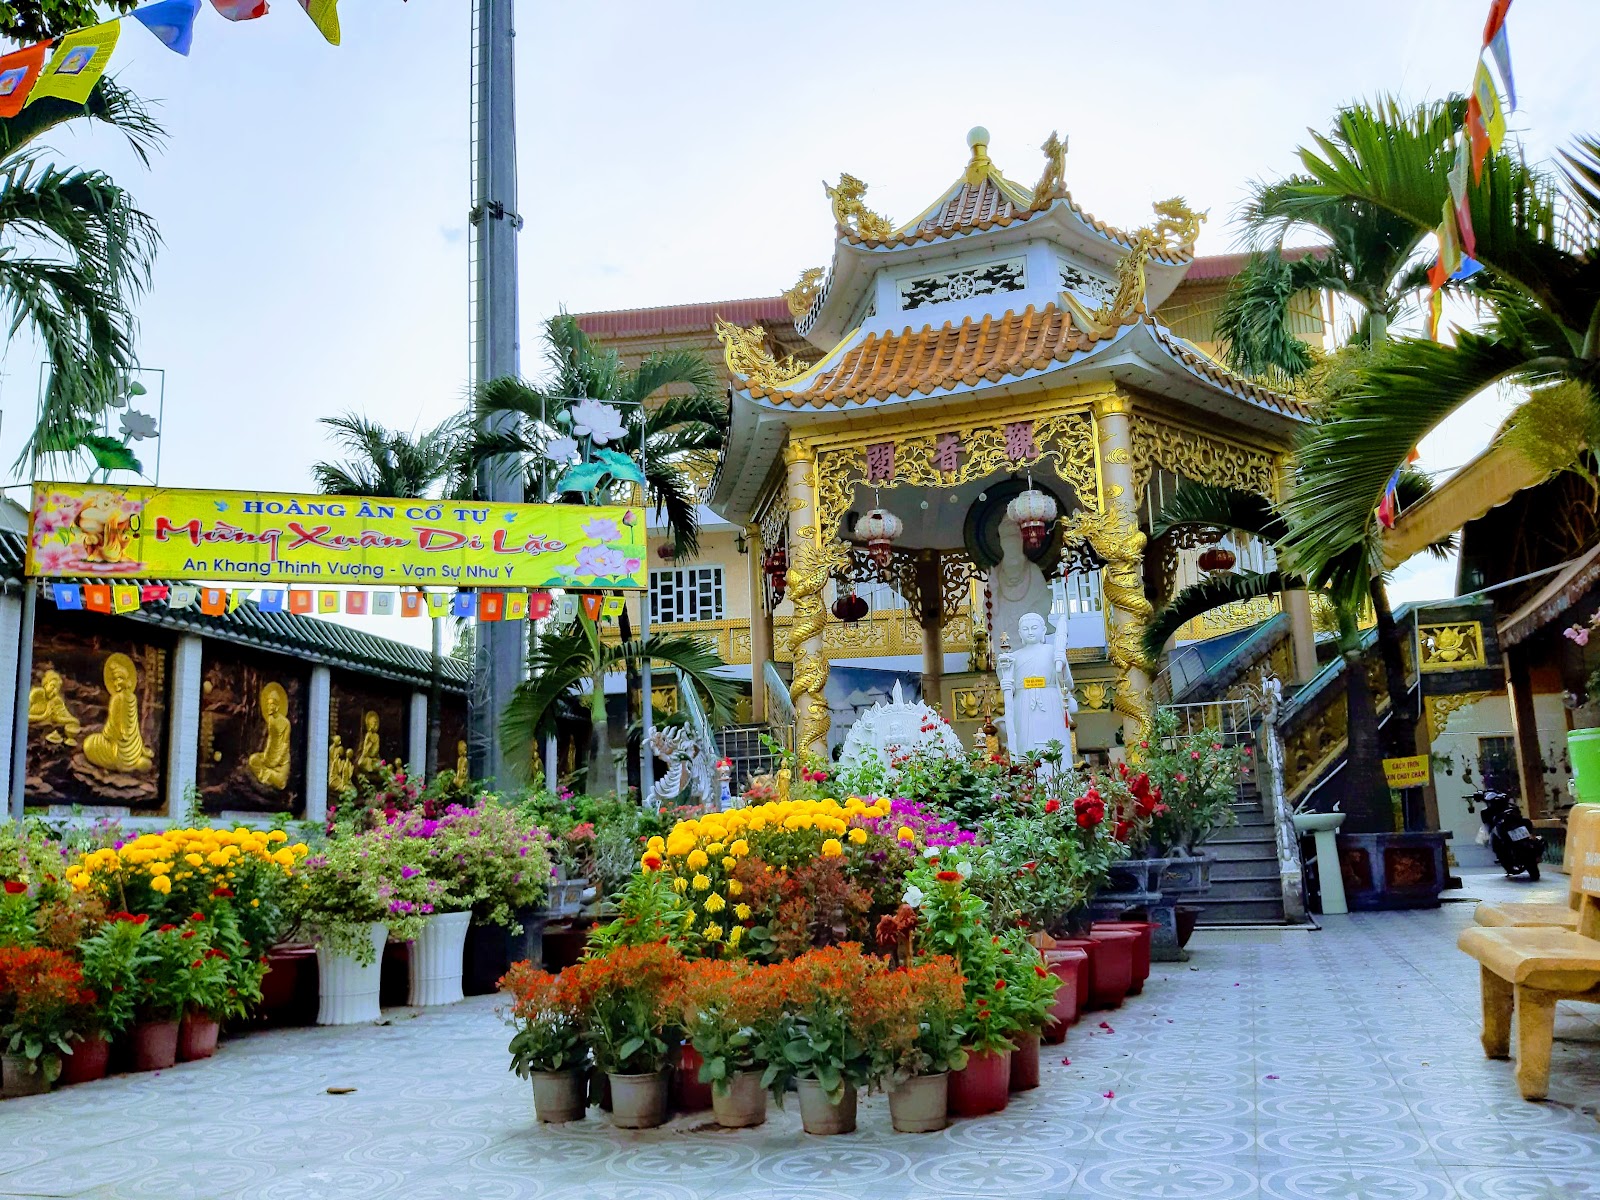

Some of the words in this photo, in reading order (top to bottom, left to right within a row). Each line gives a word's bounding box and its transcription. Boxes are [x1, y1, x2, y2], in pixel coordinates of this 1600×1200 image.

[243, 500, 346, 517] HOÀNG
[355, 502, 395, 518] ÂN
[406, 503, 445, 521] CỔ
[454, 508, 490, 524] TỰ
[156, 517, 282, 562] Mừng
[288, 522, 412, 551] Xuân
[412, 526, 484, 551] Di
[493, 529, 566, 555] Lặc
[183, 558, 207, 572] An
[214, 558, 271, 576] Khang
[277, 560, 321, 576] Thịnh
[327, 561, 384, 578] Vượng
[402, 564, 436, 580] Vạn
[442, 564, 462, 579] Sự
[467, 564, 500, 578] Như
[505, 562, 515, 578] Ý
